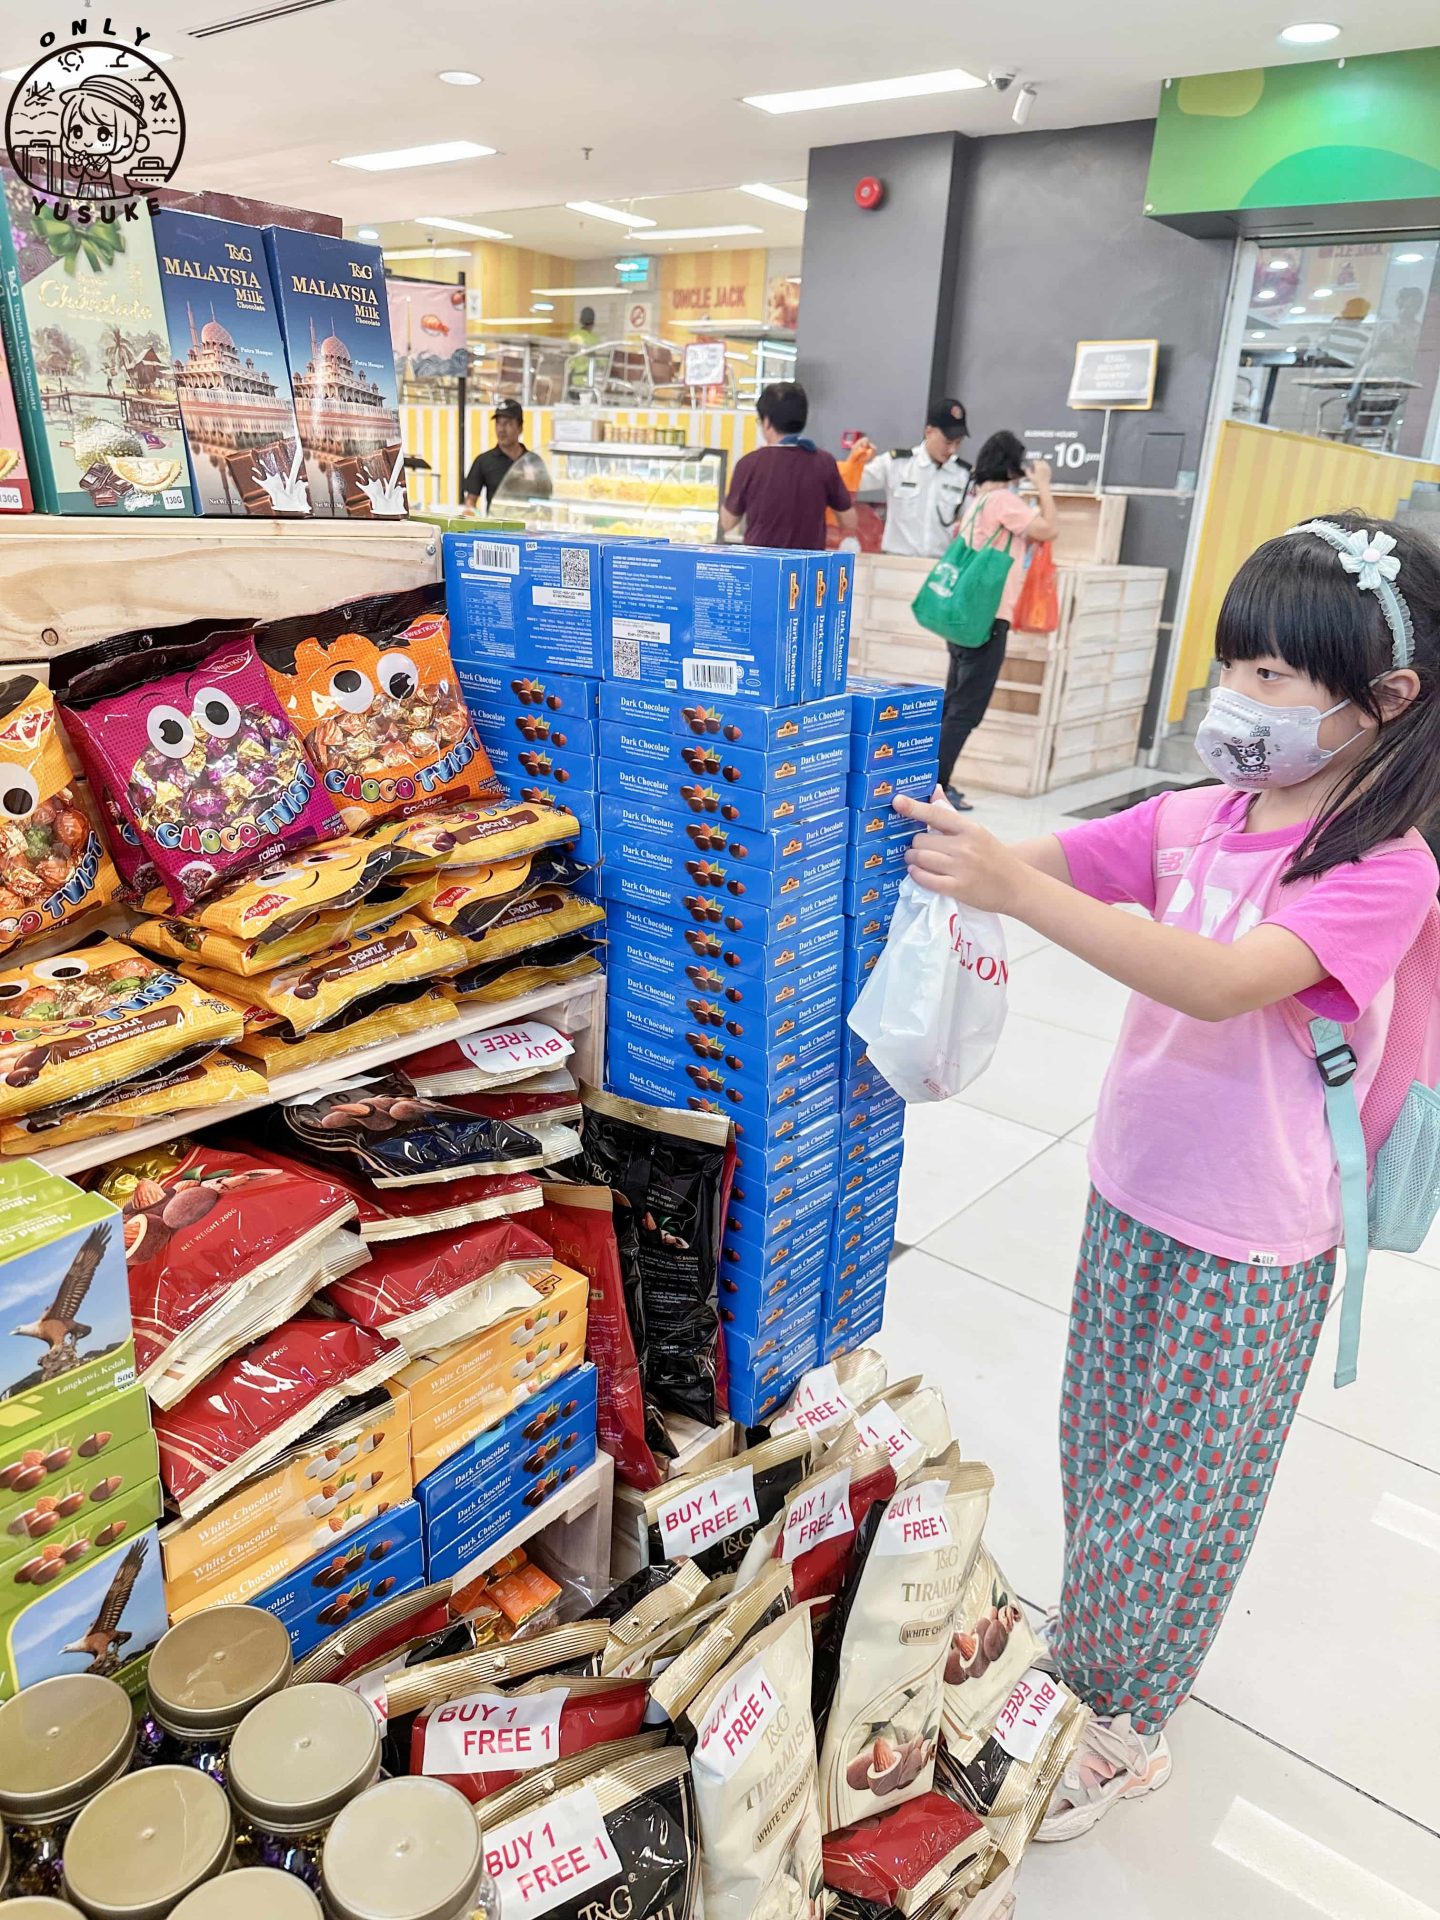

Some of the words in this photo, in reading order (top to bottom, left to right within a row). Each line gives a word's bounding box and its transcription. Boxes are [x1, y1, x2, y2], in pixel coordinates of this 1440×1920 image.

[225, 243, 252, 262] T&G
[163, 256, 261, 290] MALAYSIA
[348, 262, 373, 280] T&G
[234, 288, 264, 304] Milk
[291, 275, 379, 305] MALAYSIA
[714, 286, 746, 307] JACK
[236, 301, 266, 312] Chocolate
[354, 304, 380, 320] Milk
[355, 316, 381, 327] Chocolate
[164, 496, 183, 506] 130G
[403, 622, 443, 640] SWEETKISS
[210, 655, 248, 673] SWEETKISS
[789, 645, 798, 692] Chocolate
[816, 641, 824, 688] Chocolate
[837, 636, 845, 681] Chocolate
[459, 671, 474, 683] Dark
[475, 674, 502, 686] Chocolate
[620, 697, 637, 709] Dark
[638, 701, 670, 714] Chocolate
[803, 715, 818, 725] Dark
[819, 708, 846, 721] Chocolate
[902, 702, 915, 711] Dark
[915, 699, 938, 708] Chocolate
[620, 735, 638, 747] Dark
[639, 739, 670, 753] Chocolate
[801, 755, 816, 765] Dark
[816, 748, 843, 762] Chocolate
[323, 768, 416, 803] CHOCO
[414, 726, 481, 793] TWIST
[896, 777, 910, 786] Dark
[910, 772, 933, 783] Chocolate
[154, 821, 261, 856] CHOCO
[254, 762, 316, 836] TWIST
[622, 809, 639, 822] Dark
[640, 814, 674, 829] Chocolate
[476, 816, 512, 834] peanut
[806, 831, 819, 841] Dark
[820, 821, 844, 836] Chocolate
[257, 842, 286, 863] raisin
[622, 845, 639, 857] Dark
[640, 849, 674, 865] Chocolate
[42, 830, 104, 919] TWIST
[508, 900, 541, 918] peanut
[626, 911, 642, 922] Dark
[643, 916, 674, 933] Chocolate
[347, 941, 387, 966] peanut
[93, 971, 187, 1021] TWIST
[68, 1041, 97, 1058] kacang
[97, 1034, 118, 1048] tanah
[146, 1018, 168, 1032] coklat
[85, 1016, 143, 1043] peanut
[479, 1031, 533, 1053] FREE
[466, 1042, 479, 1057] 1
[509, 1050, 521, 1062] 1
[526, 1038, 564, 1060] BUY
[590, 1162, 612, 1184] T&G
[101, 1358, 127, 1375] Kedah
[117, 1371, 134, 1383] 50G
[430, 1370, 453, 1390] White
[455, 1348, 493, 1375] Chocolate
[433, 1404, 456, 1425] White
[457, 1381, 495, 1407] Chocolate
[796, 1402, 836, 1428] FREE
[836, 1396, 847, 1409] 1
[867, 1425, 879, 1440] 1
[900, 1429, 912, 1442] 1
[455, 1466, 474, 1485] Dark
[475, 1440, 511, 1471] Chocolate
[457, 1500, 477, 1520] Dark
[477, 1474, 512, 1505] Chocolate
[888, 1498, 914, 1520] BUY
[914, 1493, 921, 1512] 1
[198, 1518, 231, 1542] White
[233, 1485, 284, 1522] Chocolate
[665, 1496, 703, 1532] BUY
[709, 1489, 718, 1506] 1
[689, 1504, 738, 1544] FREE
[742, 1496, 751, 1513] 1
[788, 1499, 819, 1529] BUY
[820, 1491, 827, 1508] 1
[799, 1512, 835, 1543] FREE
[838, 1502, 848, 1521] 1
[458, 1535, 476, 1555] Dark
[477, 1508, 512, 1538] Chocolate
[903, 1517, 940, 1543] FREE
[938, 1516, 947, 1534] 1
[192, 1553, 226, 1578] White
[228, 1521, 280, 1557] Chocolate
[718, 1526, 755, 1559] T&G
[934, 1545, 958, 1573] T&G
[239, 1556, 290, 1593] Chocolate
[905, 1628, 931, 1640] WHITE
[1000, 1680, 1033, 1729] FREE
[1035, 1682, 1056, 1716] BUY
[438, 1703, 499, 1724] BUY
[506, 1706, 518, 1723] 1
[701, 1701, 728, 1750] BUY
[731, 1683, 741, 1703] 1
[722, 1693, 765, 1757] FREE
[760, 1680, 772, 1700] 1
[1022, 1717, 1038, 1728] 1
[463, 1726, 532, 1756] FREE
[540, 1725, 551, 1750] 1
[762, 1704, 790, 1755] T&G
[993, 1726, 1007, 1742] 1
[756, 1813, 782, 1844] WHITE
[781, 1762, 815, 1815] CHOCOLATE
[485, 1831, 534, 1877] BUY
[542, 1822, 556, 1848] 1
[517, 1846, 591, 1902] FREE
[593, 1836, 608, 1861] 1
